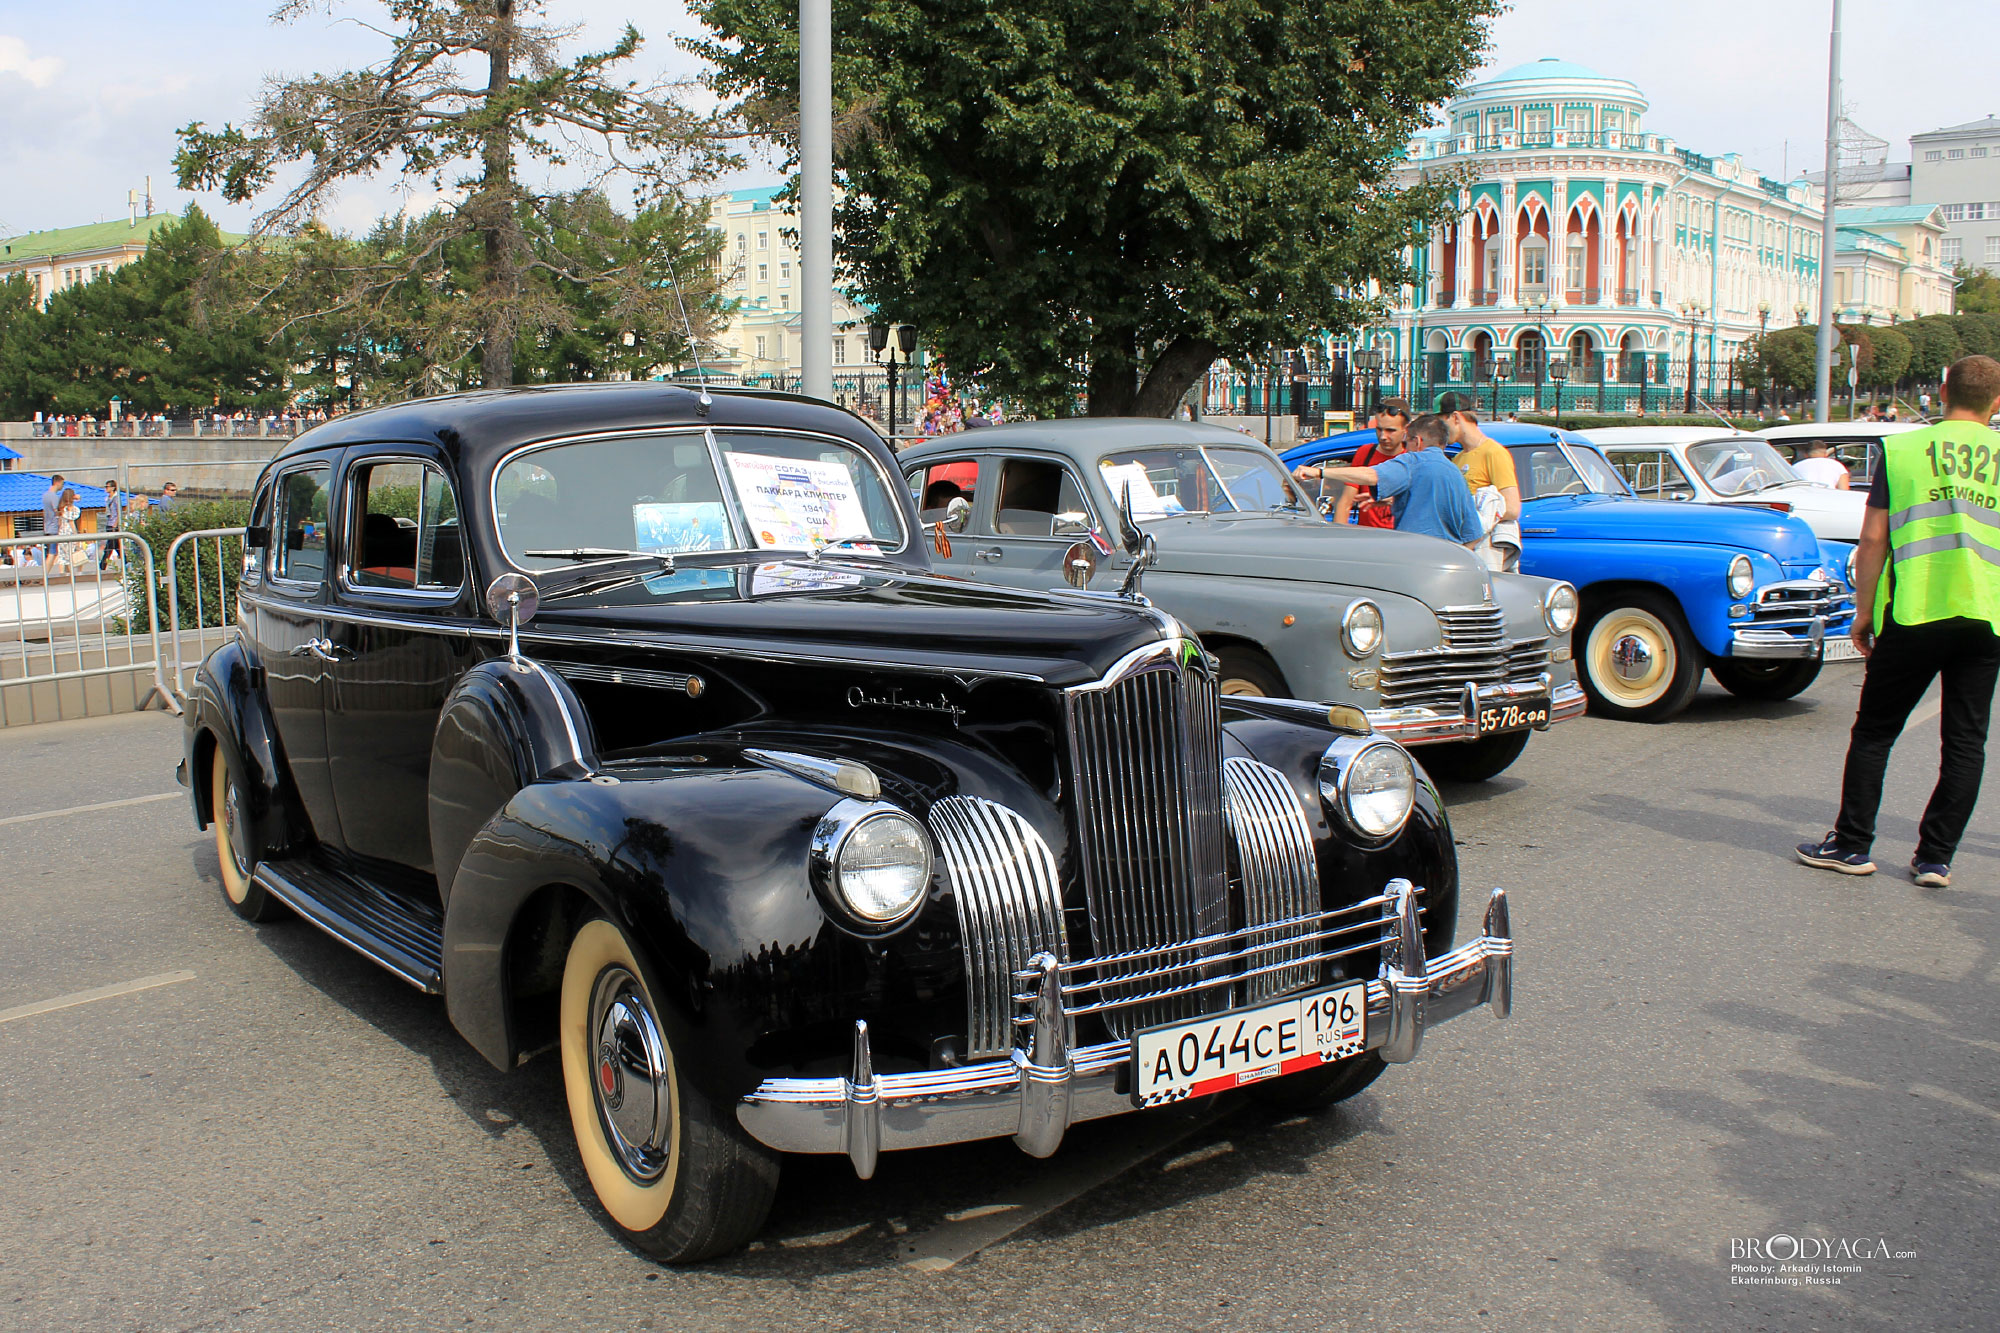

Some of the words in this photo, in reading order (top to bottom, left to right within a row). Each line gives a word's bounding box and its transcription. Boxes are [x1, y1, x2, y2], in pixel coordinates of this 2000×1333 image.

[1925, 440, 2000, 486] 15321
[756, 485, 802, 498] ПАККАРД
[803, 490, 847, 501] КЛИППЕР
[1929, 485, 1998, 510] STEWARD
[802, 504, 824, 513] 1941
[806, 516, 829, 526] США
[1305, 991, 1355, 1033] 196
[1316, 1029, 1342, 1047] RUS
[1238, 1066, 1278, 1082] CHAMPION
